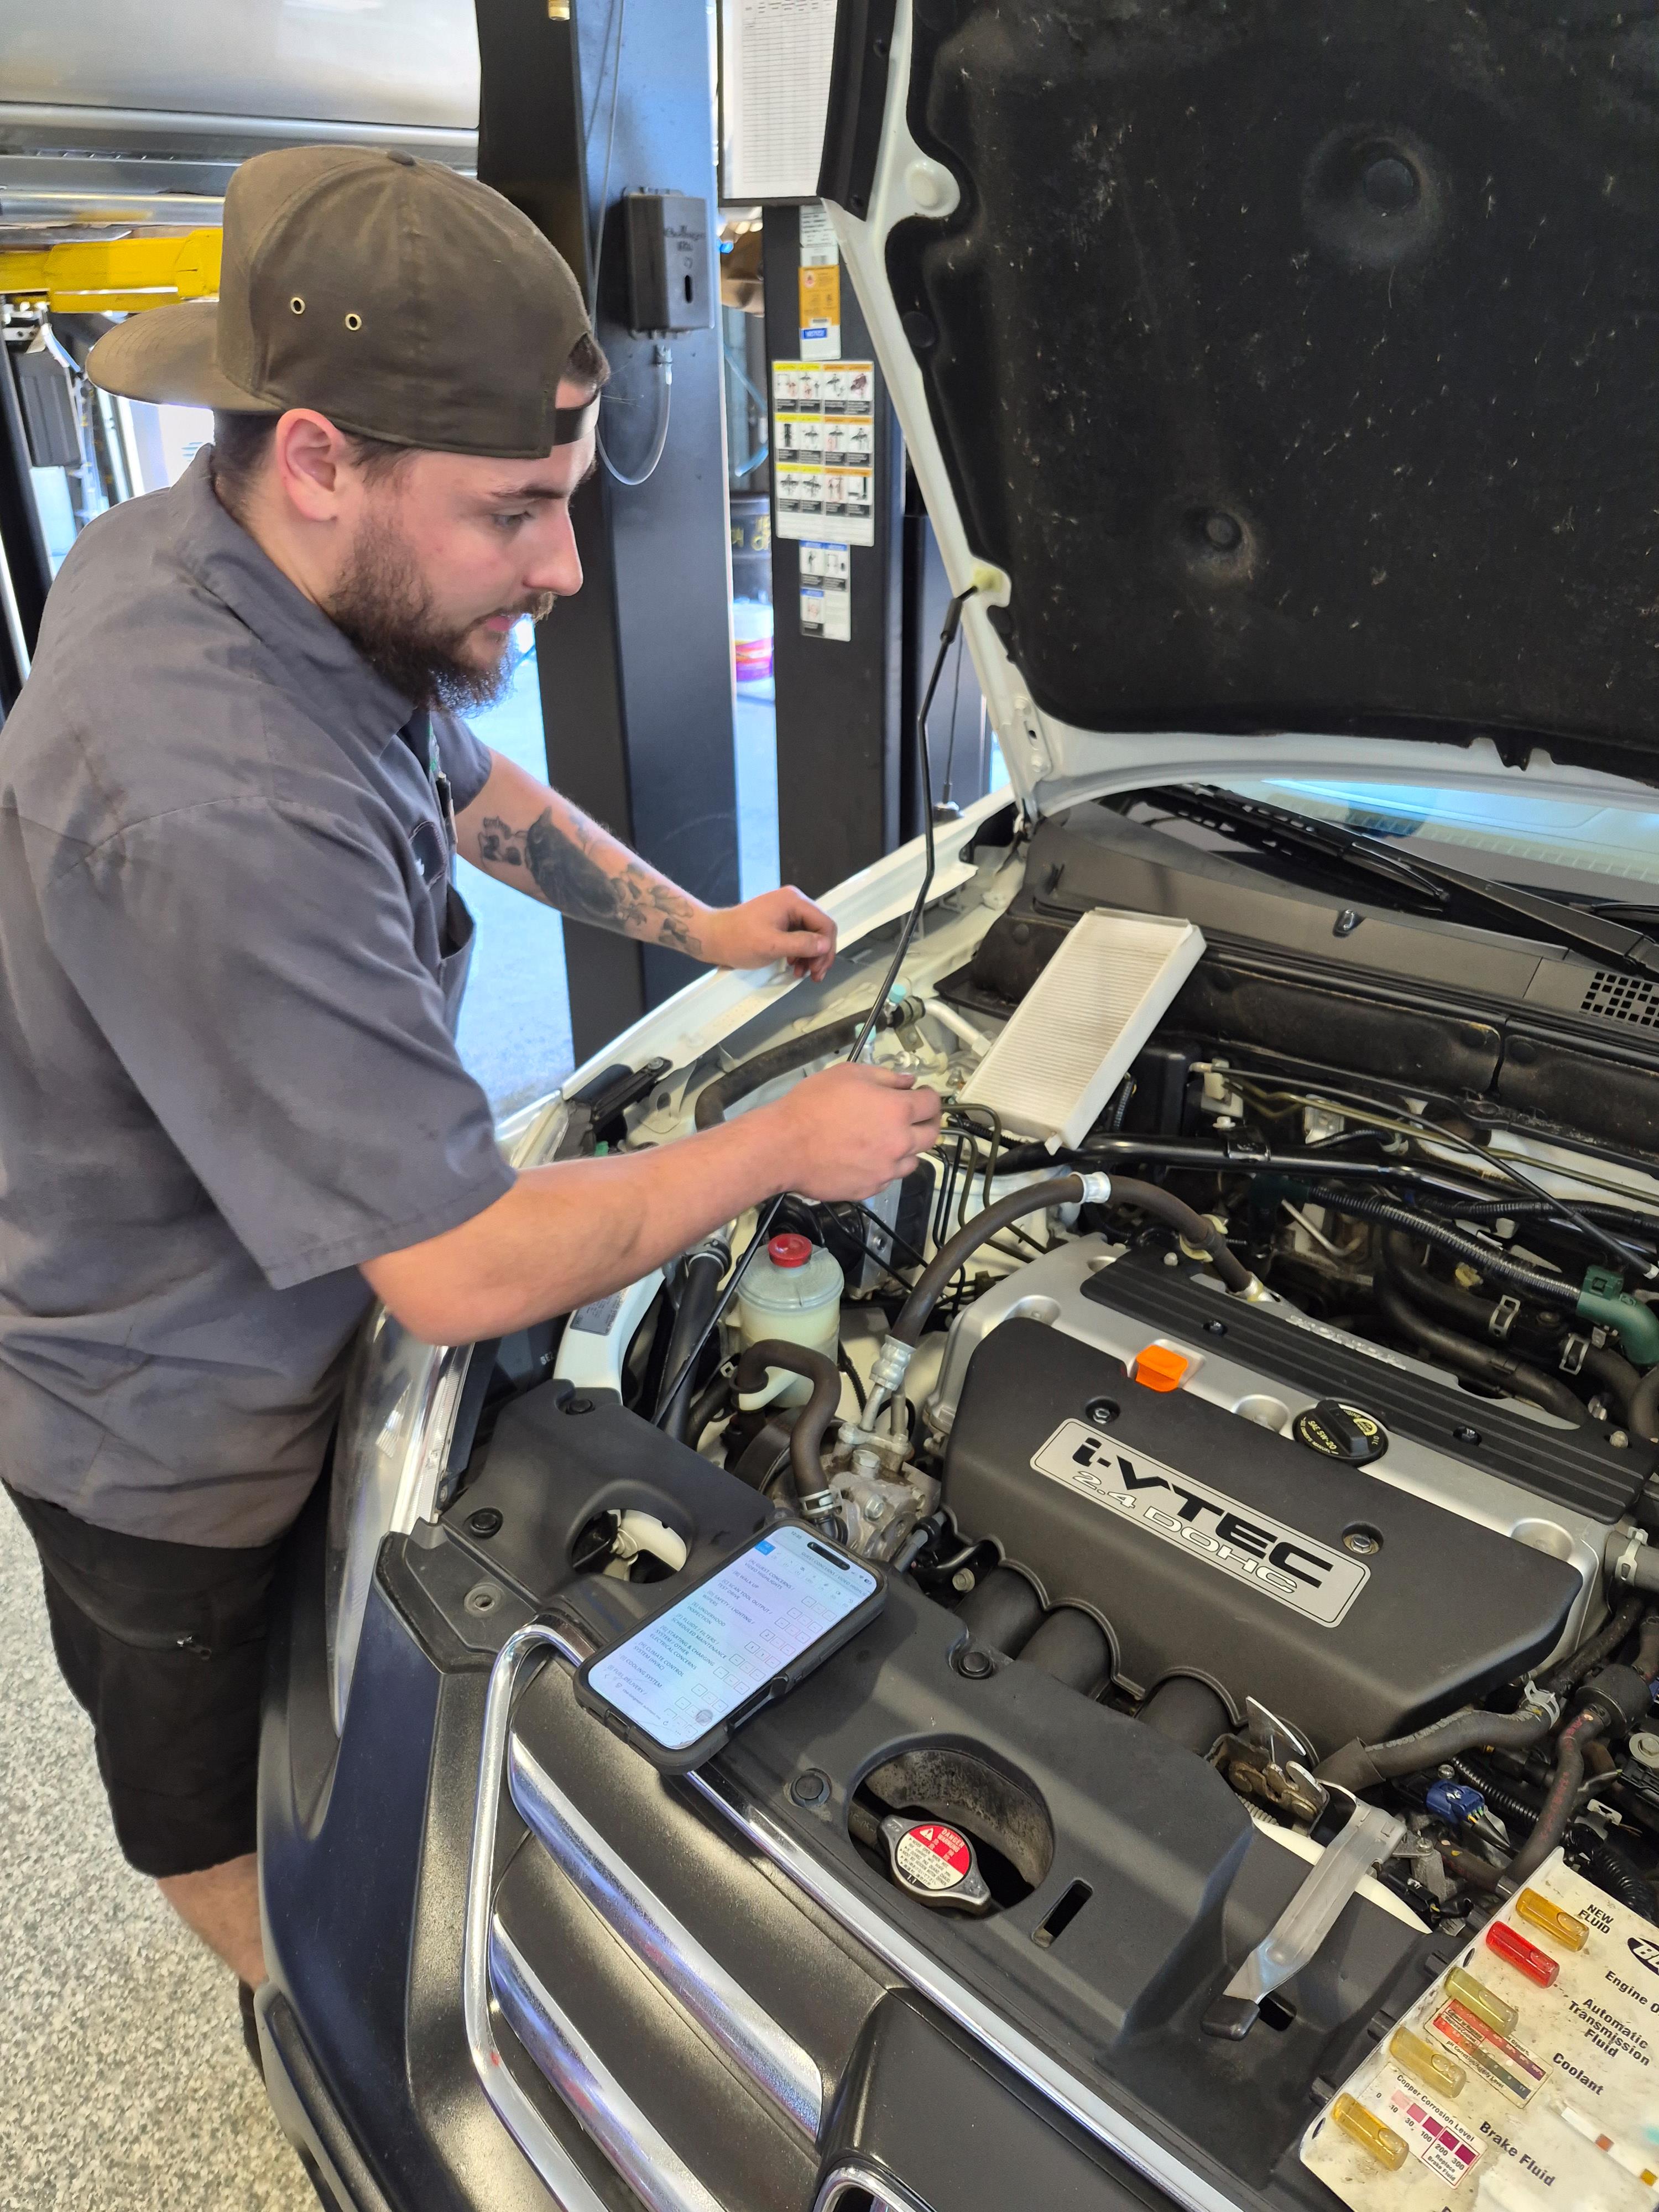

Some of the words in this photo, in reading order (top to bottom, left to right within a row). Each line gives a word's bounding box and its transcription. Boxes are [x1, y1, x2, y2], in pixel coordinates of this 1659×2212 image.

[1308, 1420, 1321, 1432] SAE
[1317, 1429, 1337, 1449] 5W-20
[1312, 1441, 1331, 1453] MANUAL
[1371, 1436, 1380, 1446] OIL
[1072, 1437, 1333, 1588] i-VTEC
[1072, 1470, 1135, 1509] 2.4
[1143, 1506, 1297, 1593] DOHC
[738, 1574, 753, 1584] WALK
[743, 1562, 759, 1573] VIDEO
[755, 1571, 784, 1589] HIGHLIGHTS
[754, 1563, 770, 1574] GUEST
[767, 1572, 794, 1589] CONCERNS
[701, 1594, 719, 1606] WIPERS
[716, 1583, 728, 1591] TEST
[726, 1589, 741, 1600] DRIVE
[727, 1583, 742, 1593] SCAN
[739, 1590, 753, 1600] TOOL
[750, 1599, 771, 1613] OUTPUT
[686, 1605, 713, 1625] INSPECTION
[696, 1606, 727, 1627] UNDERHOOD
[713, 1594, 730, 1606] SAFETY
[729, 1606, 753, 1623] LIGHTING
[654, 1629, 672, 1642] SYSTEM
[673, 1643, 689, 1655] OTHER
[670, 1617, 697, 1636] SCHEDULED
[694, 1635, 727, 1659] MAINTENANCE
[681, 1617, 698, 1630] FLUIDS
[698, 1630, 717, 1643] FILTERS
[633, 1645, 650, 1660] SYSTEM
[648, 1657, 665, 1671] (HVAC)
[649, 1633, 675, 1653] ELECTRICAL
[672, 1651, 697, 1670] CONCERNS
[666, 1630, 688, 1646] STARTING
[690, 1647, 716, 1666] CHARGING
[625, 1658, 646, 1676] COOLING
[644, 1673, 662, 1688] SYSTEM
[645, 1646, 665, 1662] CLIMATE
[662, 1660, 685, 1677] CONTROL
[612, 1668, 625, 1678] FUEL
[623, 1676, 644, 1693] DELIVERY
[936, 1834, 961, 1853] WARNING
[941, 1828, 966, 1848] DANGER
[1578, 1910, 1610, 1934] FLUID
[1587, 1904, 1614, 1924] NEW
[1605, 1970, 1648, 2005] Engine
[1650, 2003, 1659, 2017] O
[1568, 2000, 1650, 2066] Transmission
[1583, 1999, 1648, 2049] Automatic
[1584, 2028, 1619, 2058] Fluid
[1490, 2076, 1504, 2088] Level
[1553, 2053, 1604, 2095] Coolant
[1397, 2074, 1421, 2096] Copper
[1421, 2095, 1454, 2125] Corrosion
[1454, 2124, 1475, 2142] Level
[1405, 2117, 1415, 2127] 30
[1420, 2130, 1432, 2143] 100
[1434, 2143, 1448, 2156] 200
[1451, 2157, 1465, 2171] 300
[1479, 2121, 1517, 2157] Brake
[1519, 2154, 1556, 2187] Fluid
[1427, 2156, 1442, 2171] Brake
[1442, 2168, 1456, 2182] Fluid
[1435, 2154, 1456, 2173] Replace
